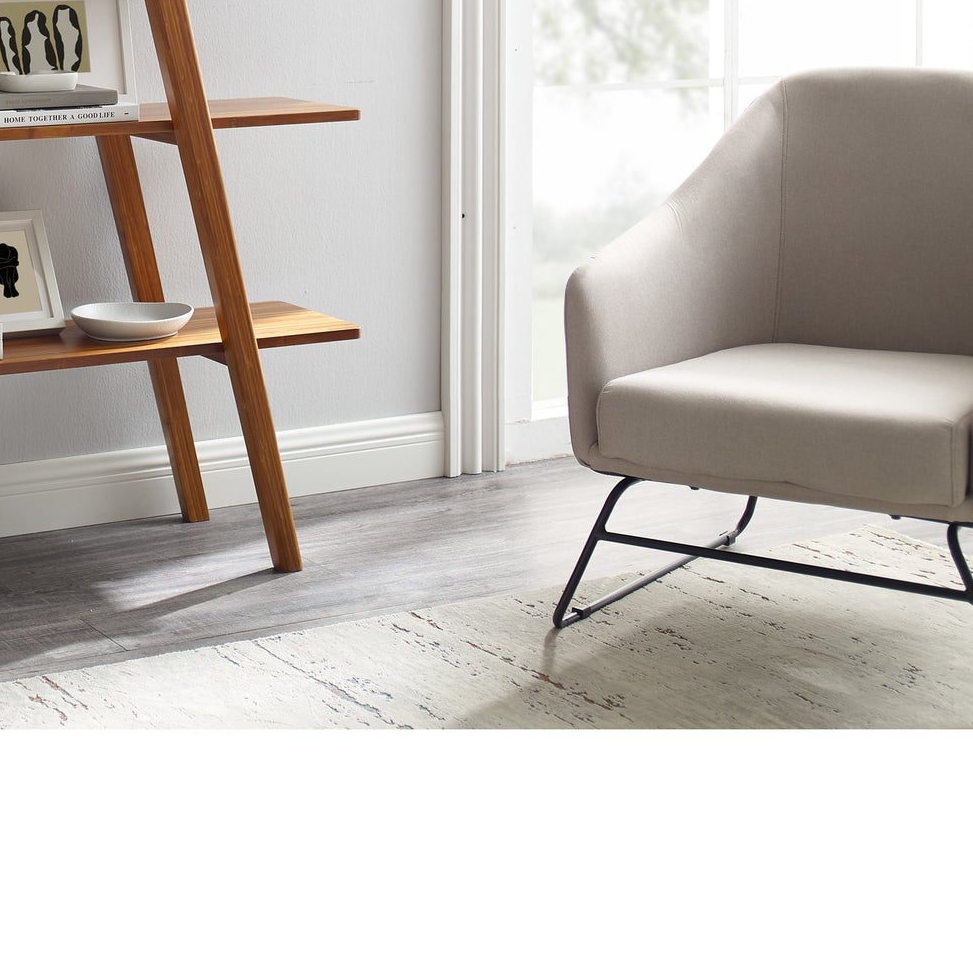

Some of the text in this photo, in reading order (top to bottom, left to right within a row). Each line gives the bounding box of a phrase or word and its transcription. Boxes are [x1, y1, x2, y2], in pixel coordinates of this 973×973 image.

[3, 116, 26, 124] HOME
[29, 114, 68, 123] TOGETHER
[77, 112, 99, 120] GOOD
[99, 111, 116, 119] LIFE
